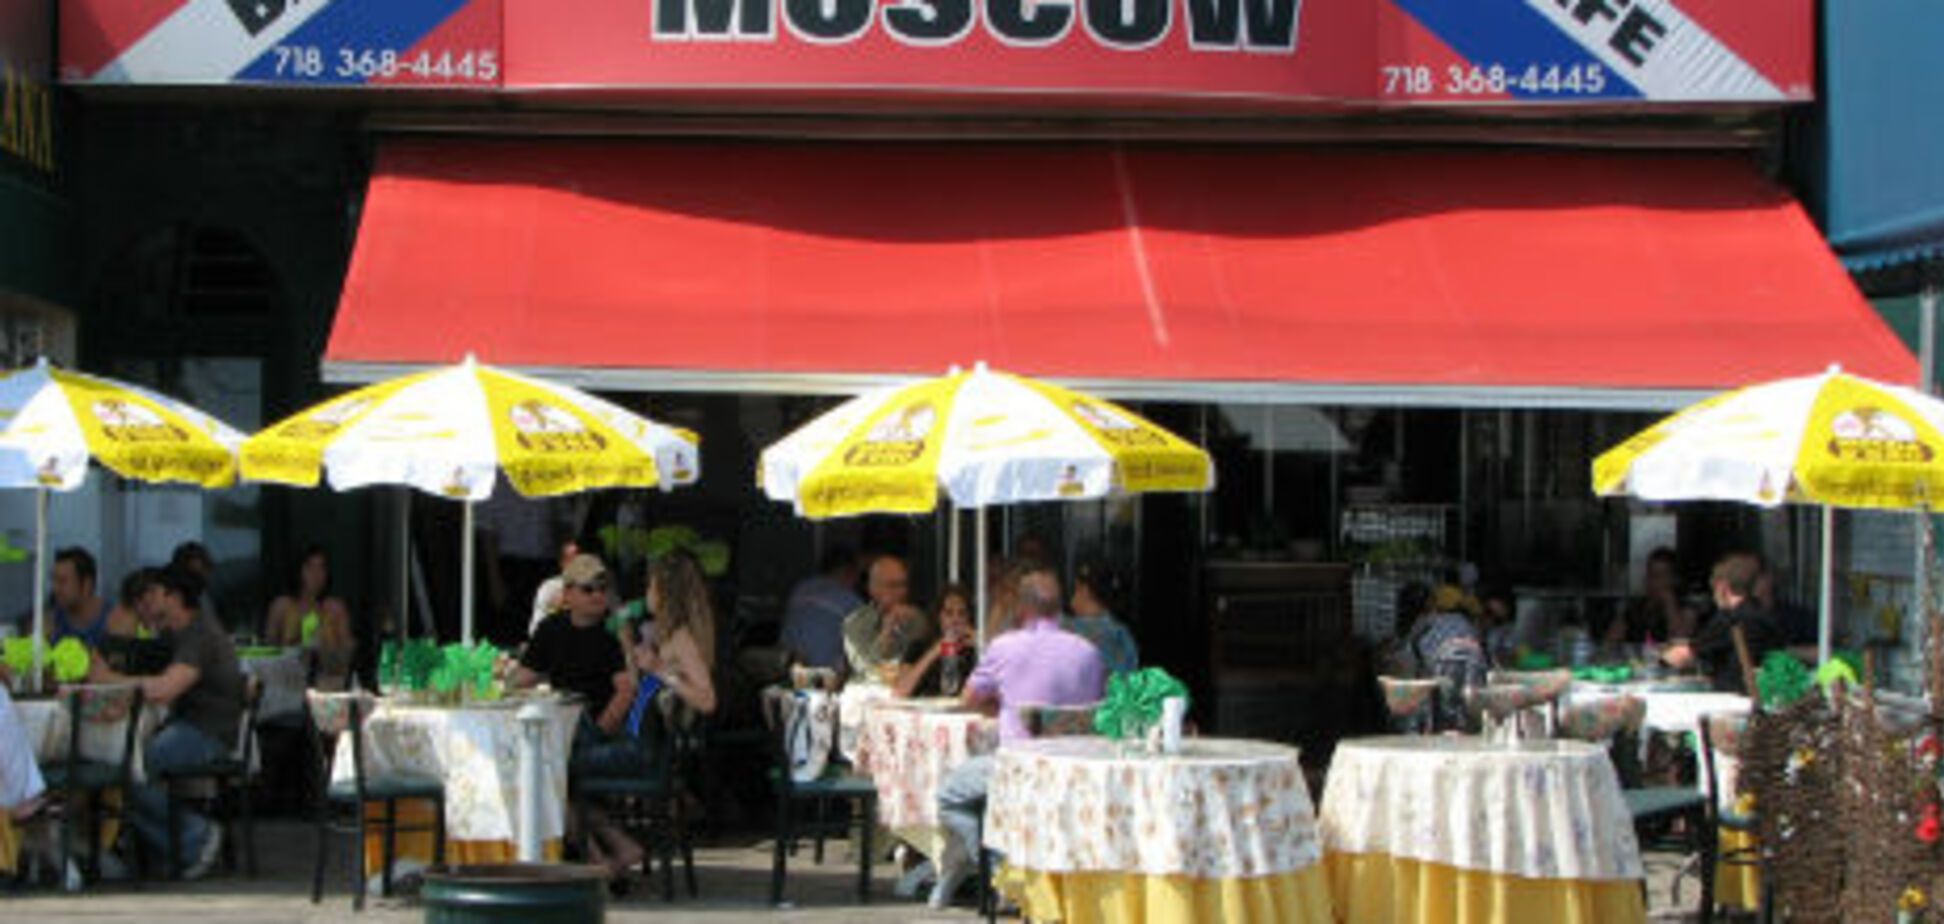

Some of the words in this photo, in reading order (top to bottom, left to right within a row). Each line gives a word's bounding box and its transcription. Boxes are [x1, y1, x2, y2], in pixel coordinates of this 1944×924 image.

[274, 47, 323, 77] 718
[336, 49, 498, 80] 368-4445
[1383, 65, 1432, 94] 718
[1448, 63, 1606, 94] 368-4445
